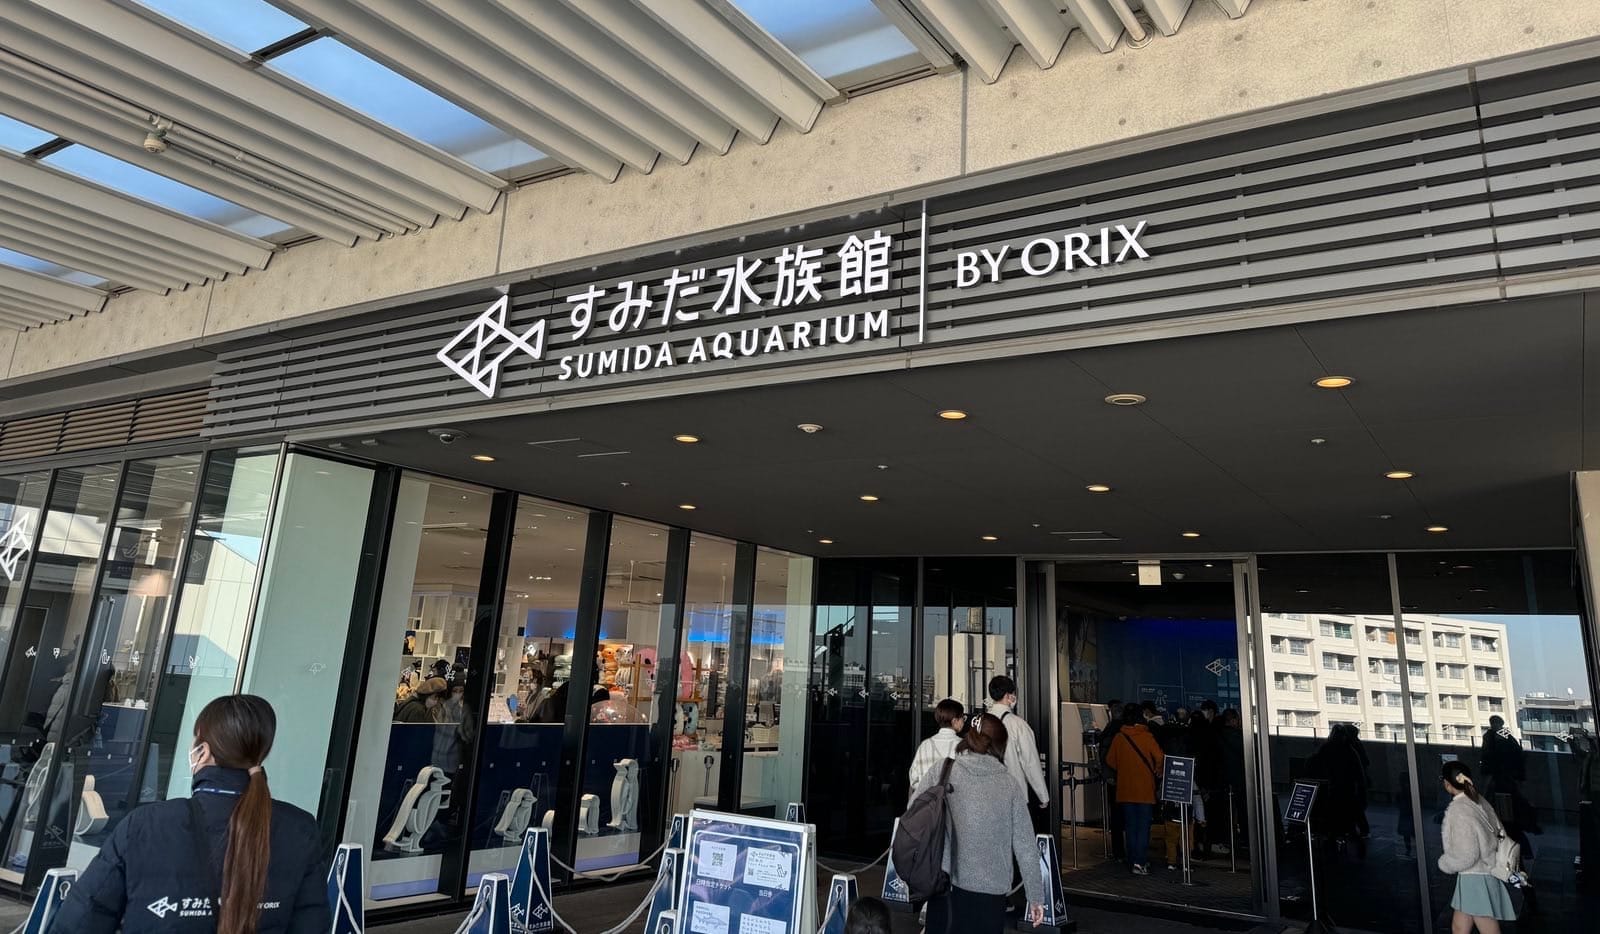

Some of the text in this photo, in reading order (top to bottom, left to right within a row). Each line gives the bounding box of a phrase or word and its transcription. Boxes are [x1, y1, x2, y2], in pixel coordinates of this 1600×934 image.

[566, 230, 892, 341] すみだ水族館
[957, 220, 1150, 288] BY ORIX
[558, 309, 889, 380] SUMIDA AQUARIUM
